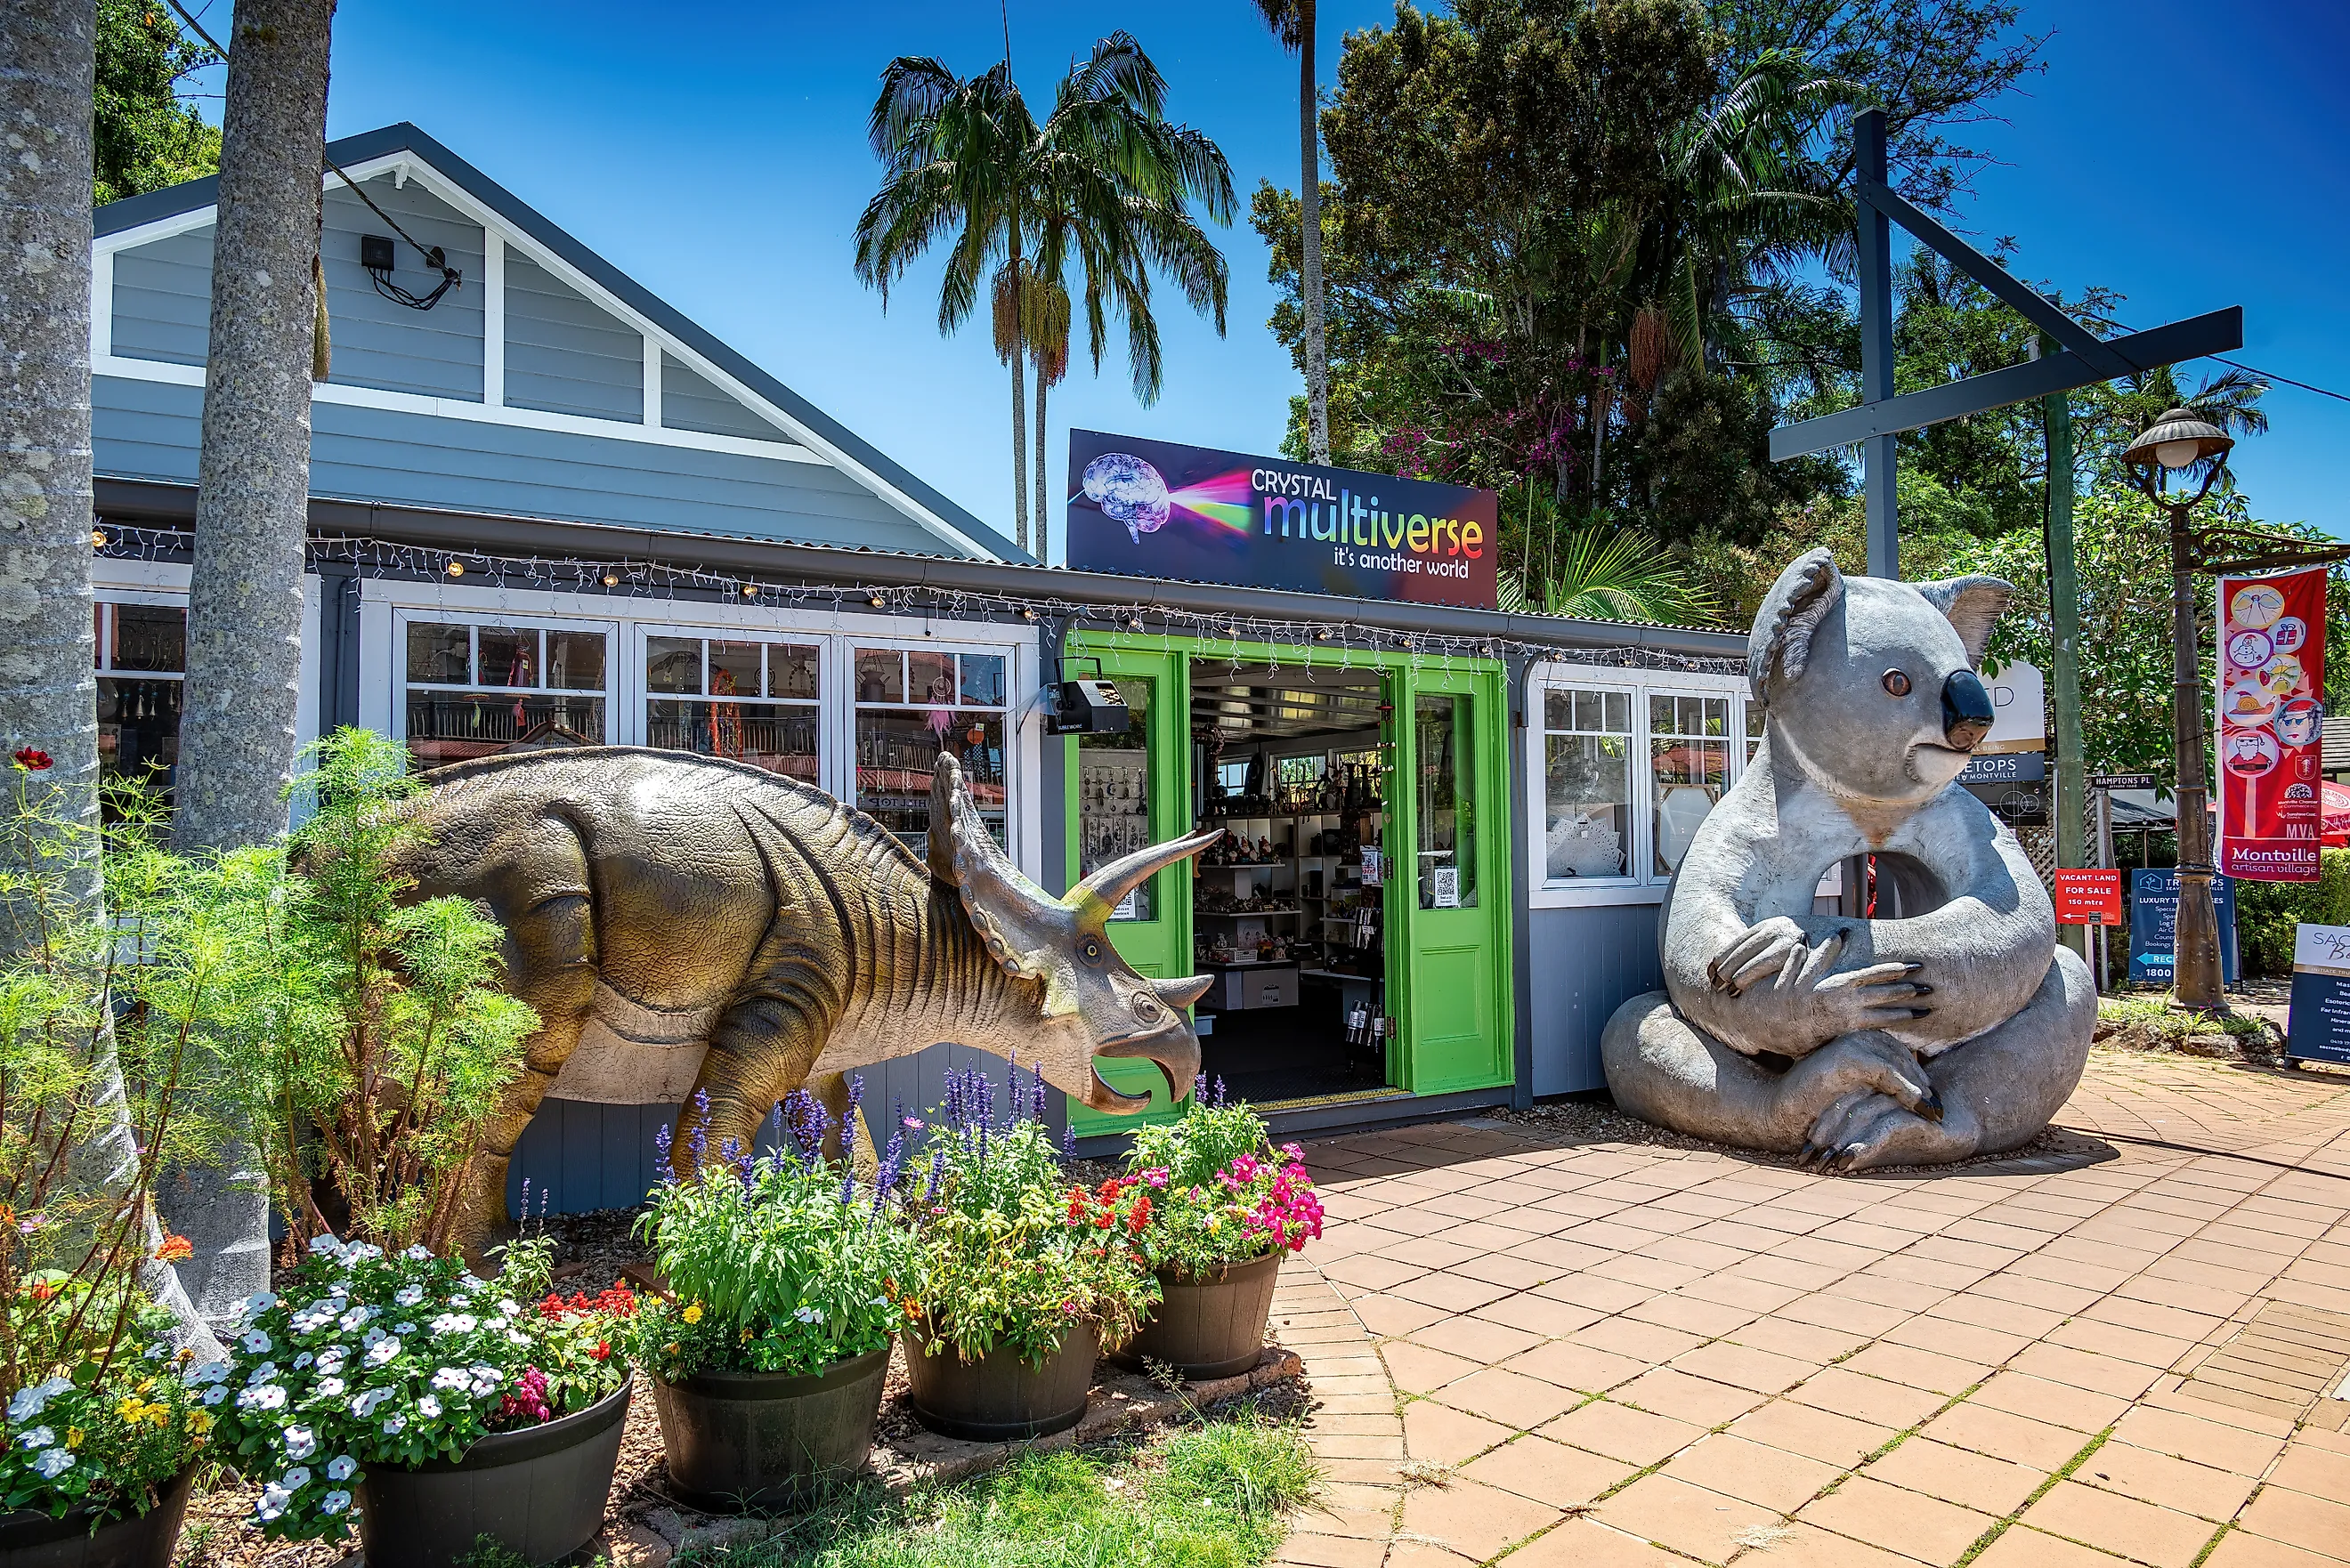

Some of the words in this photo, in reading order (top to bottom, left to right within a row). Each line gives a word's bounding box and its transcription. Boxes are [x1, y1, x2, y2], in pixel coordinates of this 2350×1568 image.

[1251, 468, 1337, 501] CRYSTAL
[1264, 489, 1484, 560] multiverse
[1333, 546, 1357, 568] it's
[1359, 550, 1422, 576] another
[1426, 559, 1470, 579] world
[1969, 772, 2017, 780] MONTVILLE
[2095, 777, 2138, 785] HAMPTONS
[2232, 847, 2317, 862] Montville
[2231, 862, 2275, 872] artisan
[2277, 863, 2317, 876] village
[2065, 886, 2085, 894] FOR
[2087, 886, 2111, 894] SALE
[2145, 968, 2172, 977] 1800
